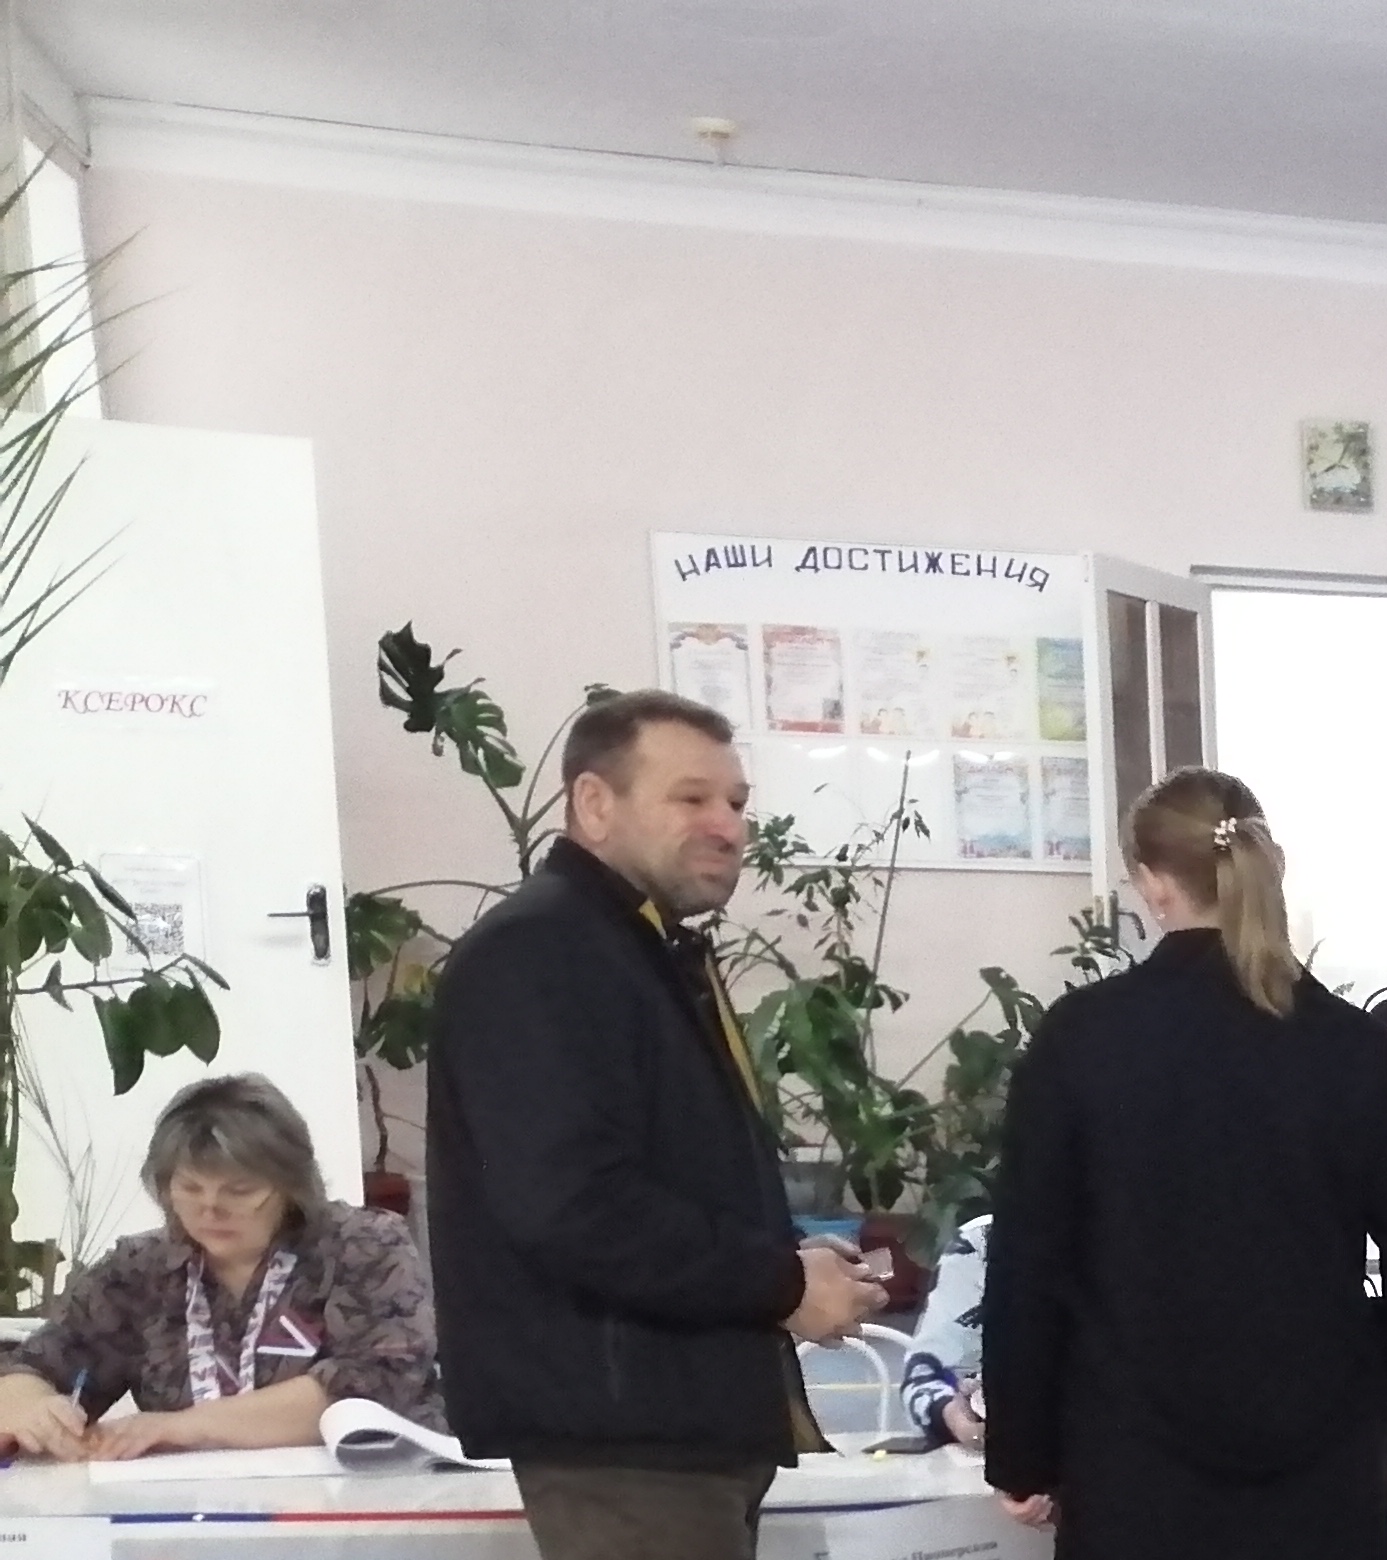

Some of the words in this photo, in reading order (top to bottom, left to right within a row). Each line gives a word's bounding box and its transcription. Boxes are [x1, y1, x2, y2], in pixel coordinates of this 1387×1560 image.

[674, 544, 774, 583] НАШИ
[794, 545, 1051, 593] ДОСТИЖЕНИЯ
[57, 689, 208, 718] КСЕРОКС
